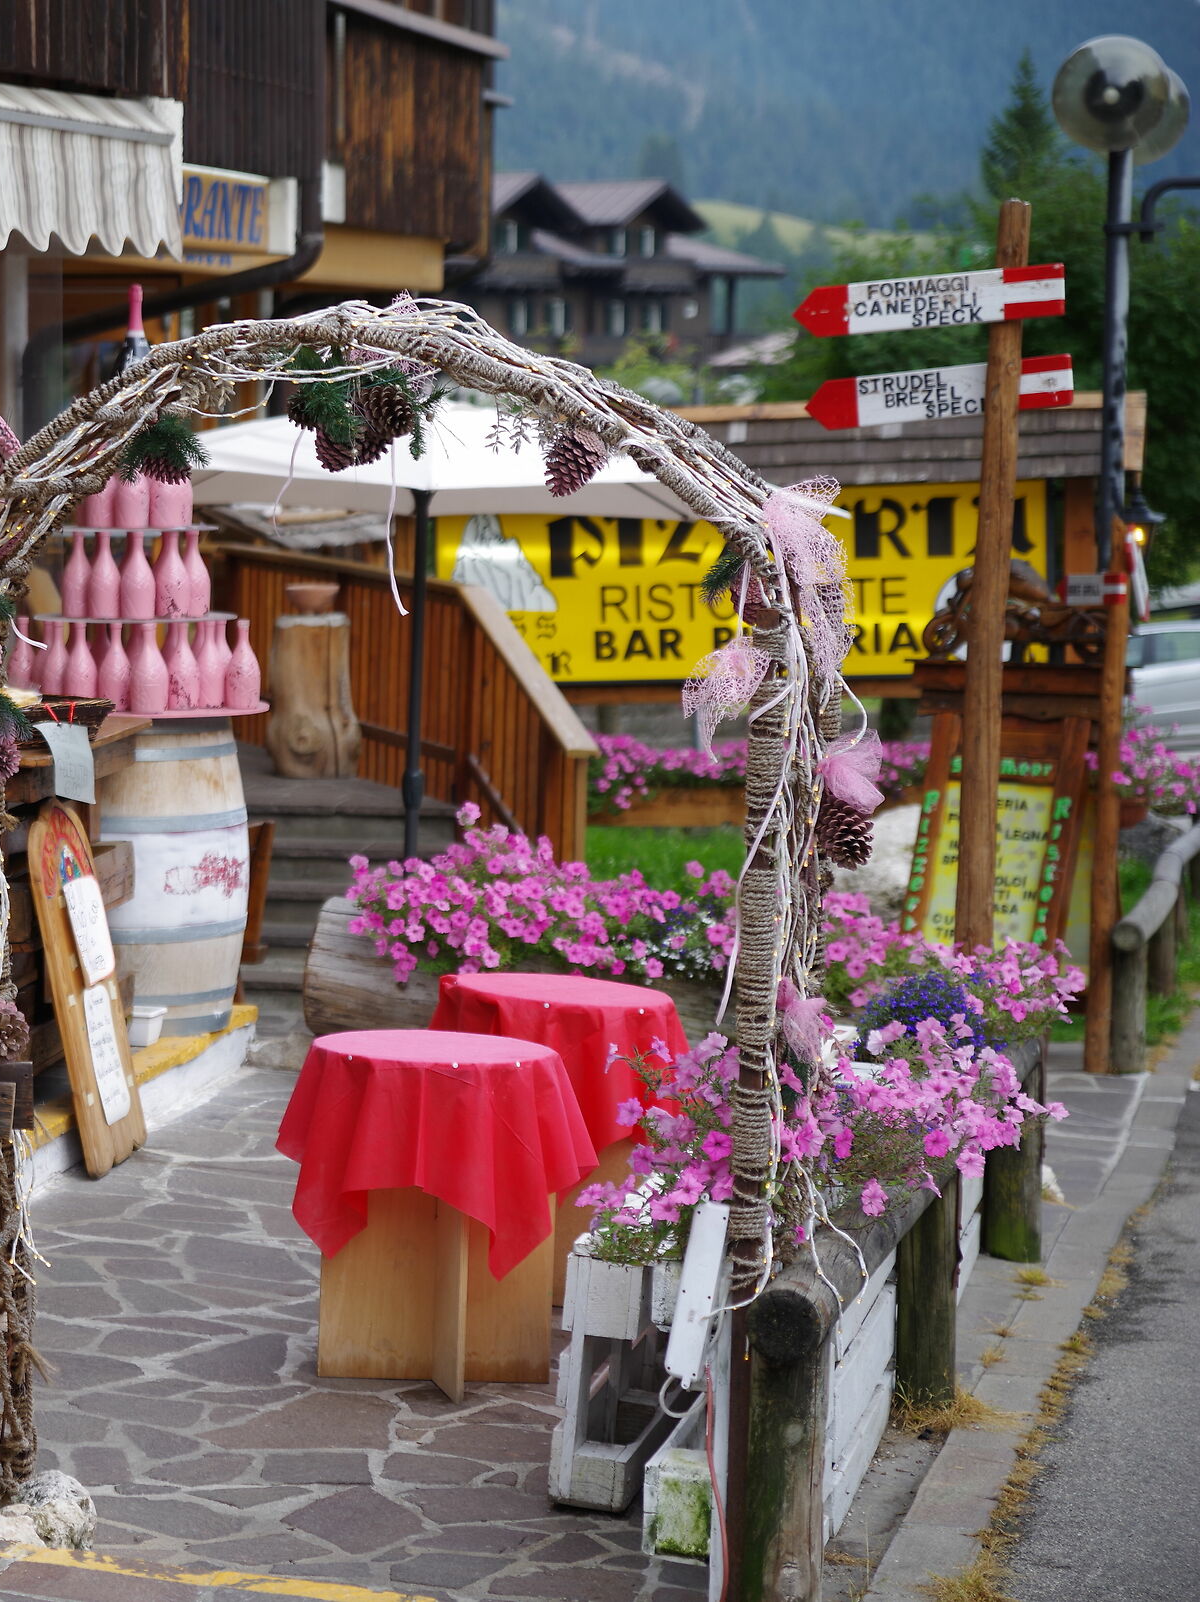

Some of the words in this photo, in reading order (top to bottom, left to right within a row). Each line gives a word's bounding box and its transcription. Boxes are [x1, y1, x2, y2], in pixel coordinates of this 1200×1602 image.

[180, 175, 265, 244] RANTE
[867, 275, 969, 300] FORMAGGI
[854, 291, 978, 317] CANEDERLI
[912, 306, 984, 327] SPECK
[859, 371, 948, 394] STRUDEL
[884, 385, 962, 409] BREZEL
[601, 577, 908, 624] RISTOTE
[595, 627, 683, 662] BAR
[996, 799, 1028, 812] ERIA
